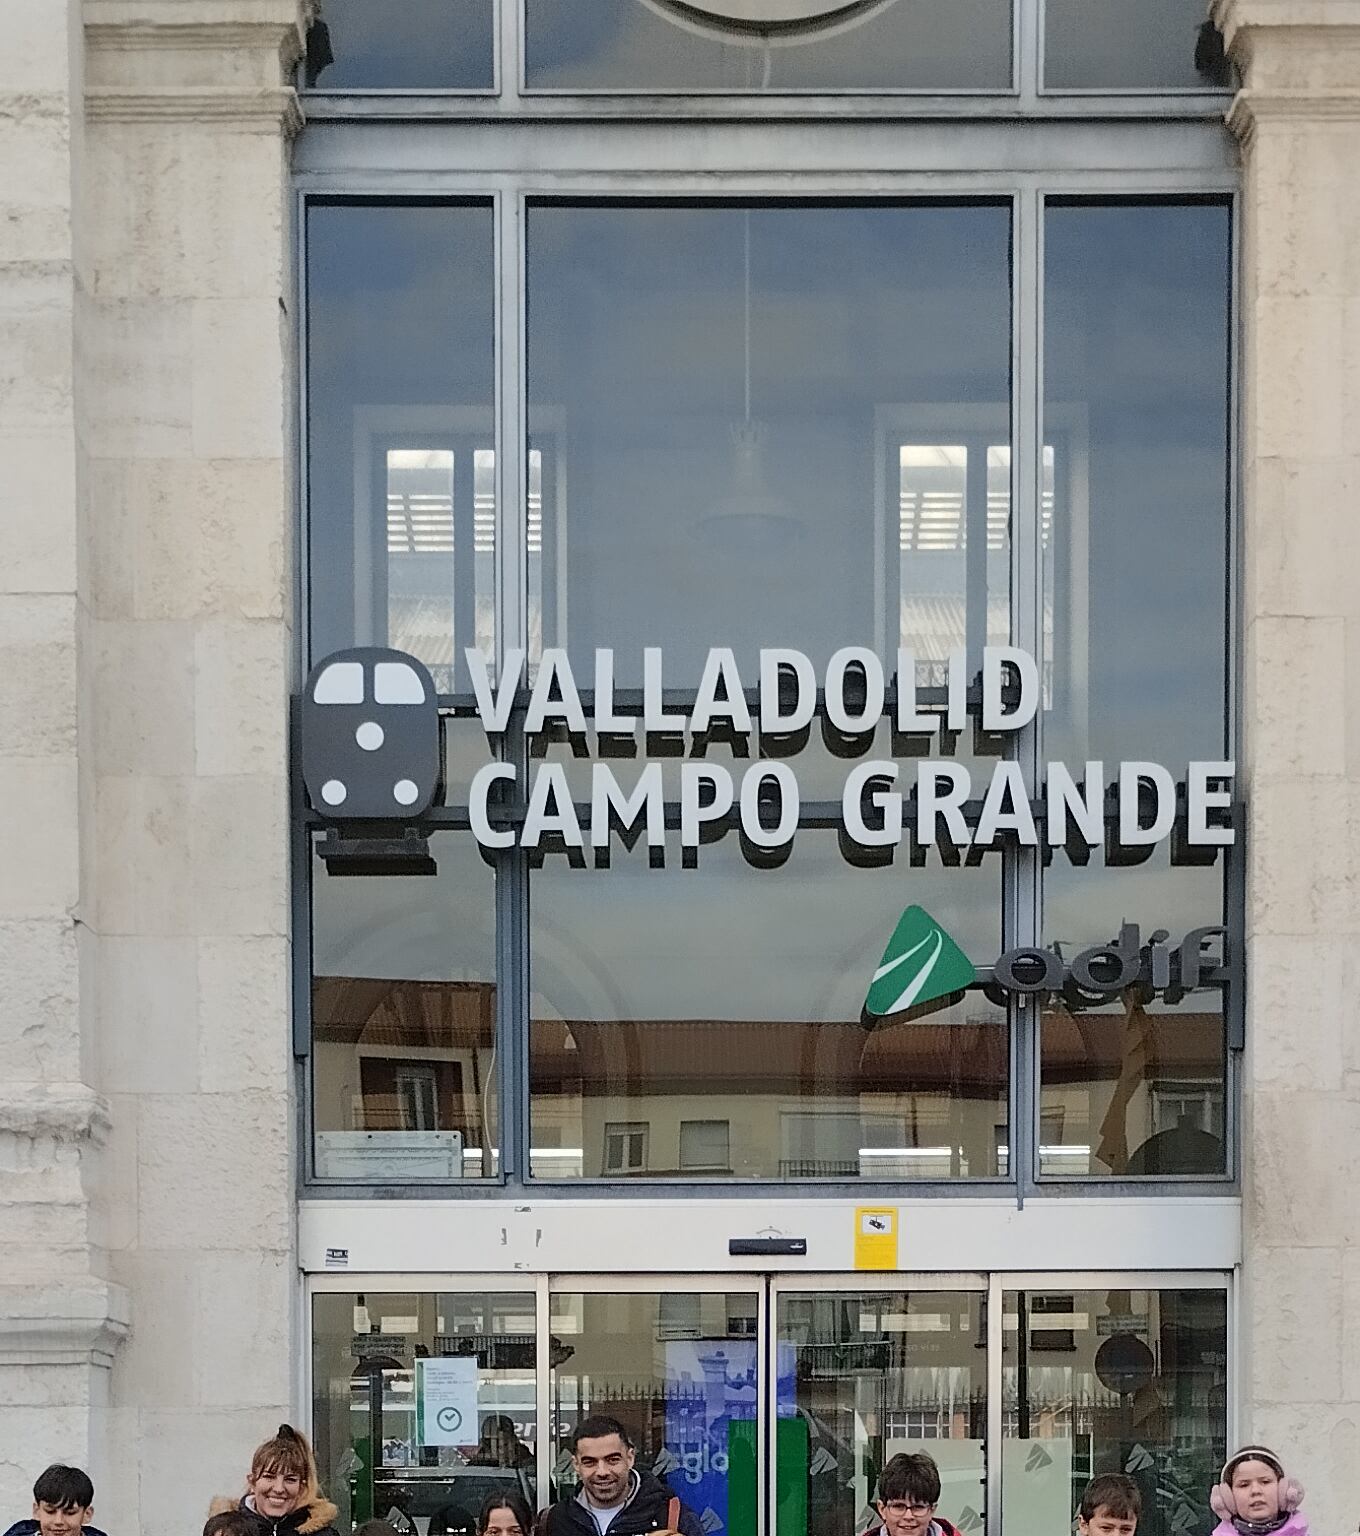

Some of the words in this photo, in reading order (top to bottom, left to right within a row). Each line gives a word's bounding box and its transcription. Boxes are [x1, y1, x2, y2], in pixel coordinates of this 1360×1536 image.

[463, 645, 1042, 735] VALLADOLID
[468, 760, 800, 849] CAMPO
[843, 760, 1235, 848] GRANDE
[993, 922, 1228, 991] adif
